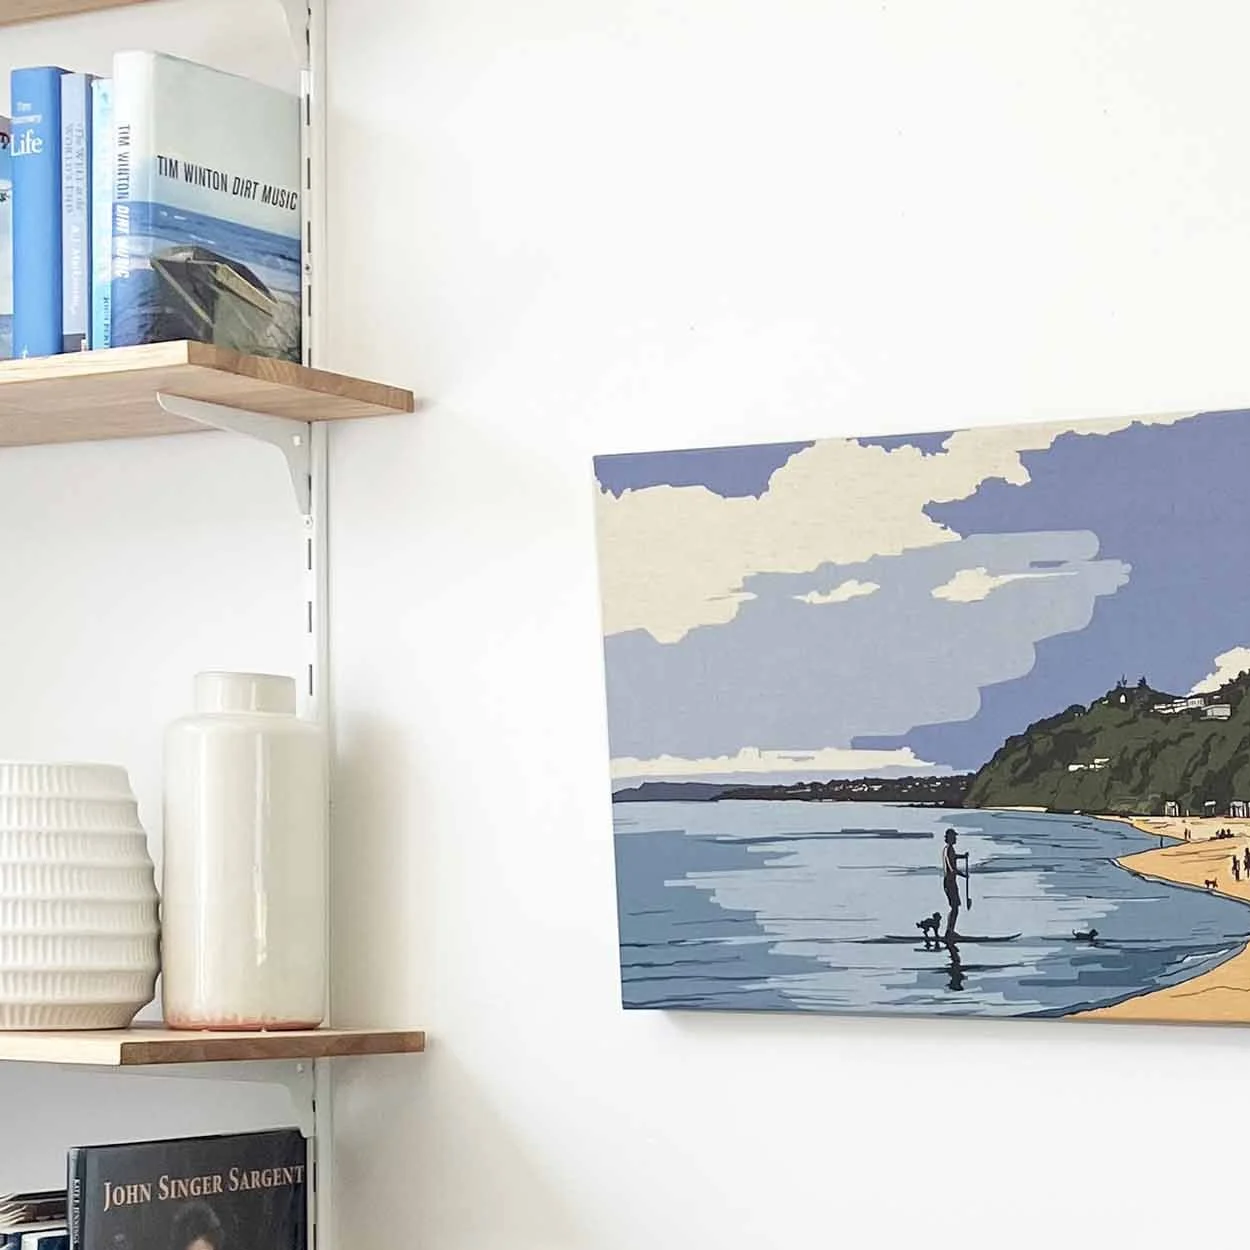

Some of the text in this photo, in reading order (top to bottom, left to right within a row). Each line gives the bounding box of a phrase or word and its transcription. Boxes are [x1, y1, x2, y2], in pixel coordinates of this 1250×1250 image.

[10, 129, 44, 157] Life
[117, 123, 131, 147] TIM
[116, 151, 131, 200] WINTON
[157, 155, 299, 211] TIM WINTON DIRT MUSIC
[103, 1164, 305, 1212] JOHN SINGER SARGENT
